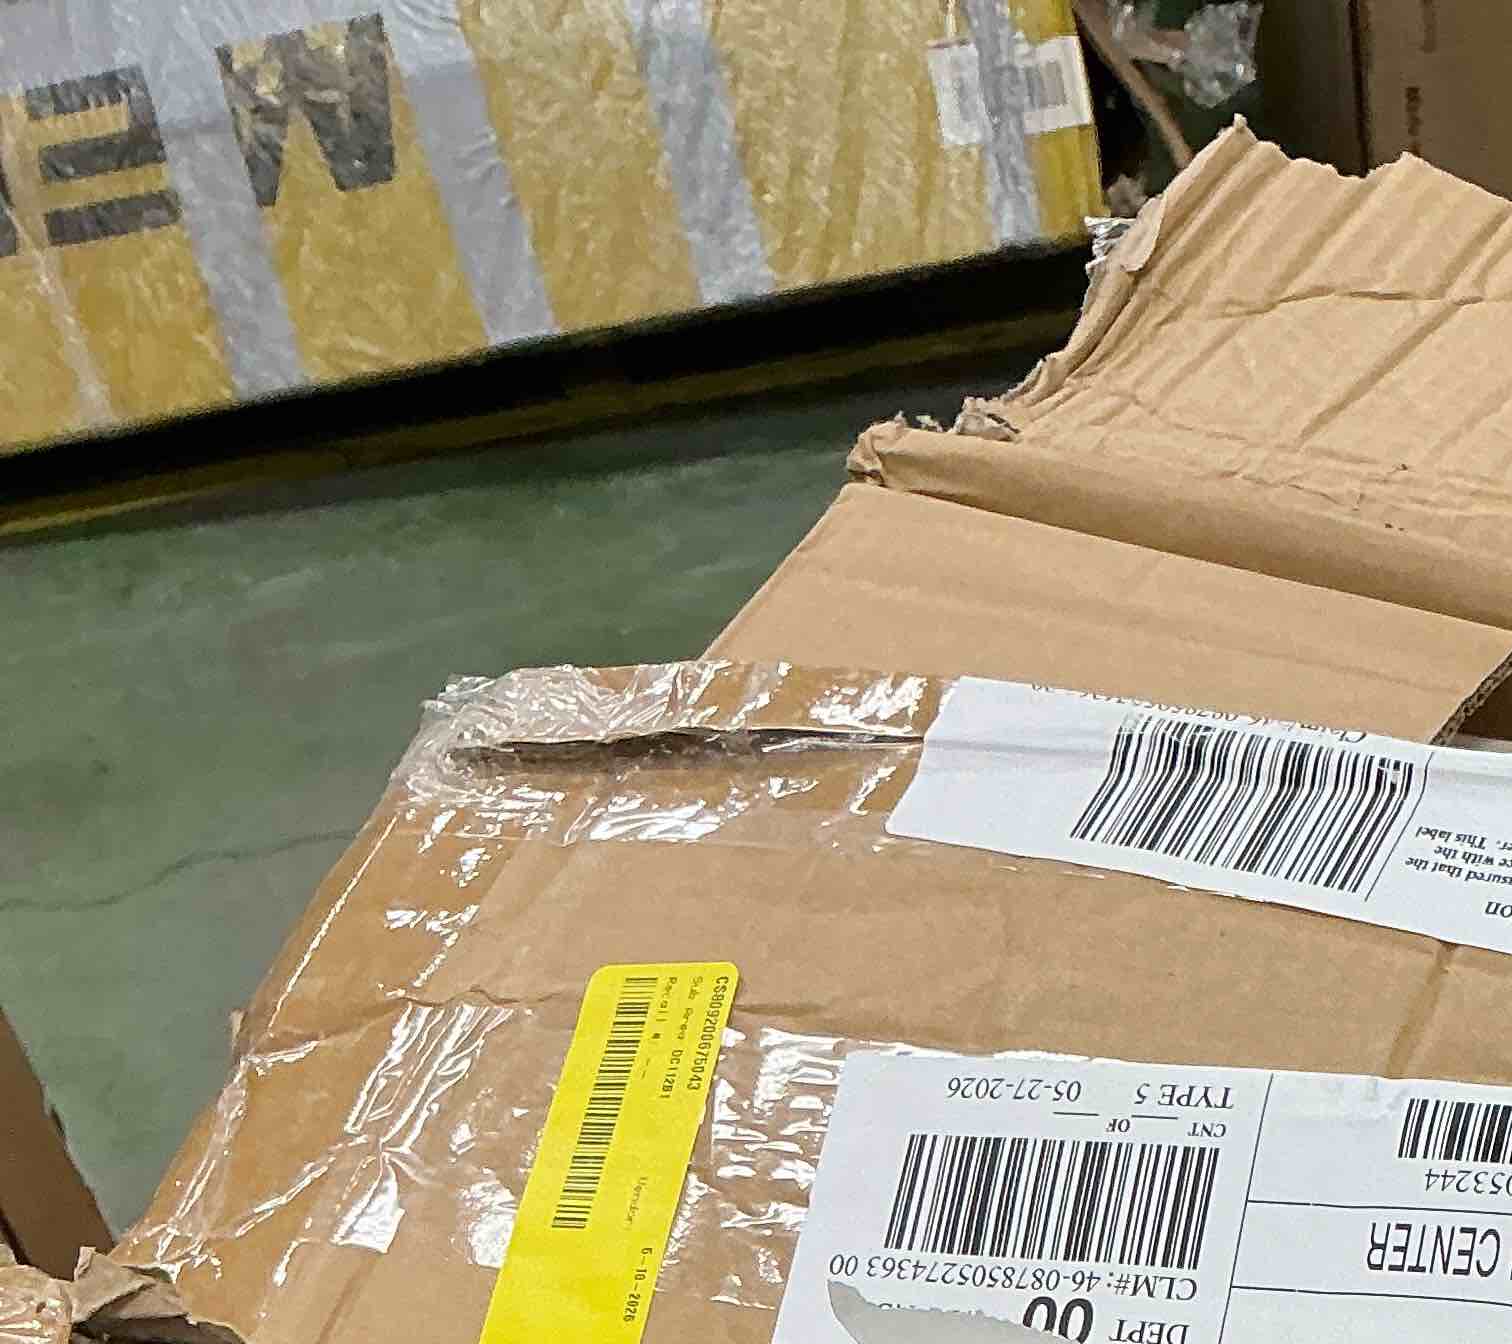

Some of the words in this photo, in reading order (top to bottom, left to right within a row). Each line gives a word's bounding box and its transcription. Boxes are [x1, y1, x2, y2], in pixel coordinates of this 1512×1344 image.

[1416, 826, 1452, 844] label
[1455, 833, 1487, 850] This
[1434, 845, 1457, 860] the
[1462, 851, 1494, 867] with
[1405, 857, 1428, 871] the
[1432, 863, 1462, 879] that
[947, 1077, 1082, 1102] 05-27-2026
[1134, 1083, 1150, 1104] 5
[1158, 1083, 1234, 1109] TYPE
[1105, 1117, 1130, 1132] OF
[1188, 1121, 1227, 1138] CNT
[1366, 1222, 1501, 1278] CENTER
[829, 1253, 859, 1277] 00
[867, 1255, 1102, 1293] 46-0878505274363
[1105, 1271, 1198, 1301] CLM#:
